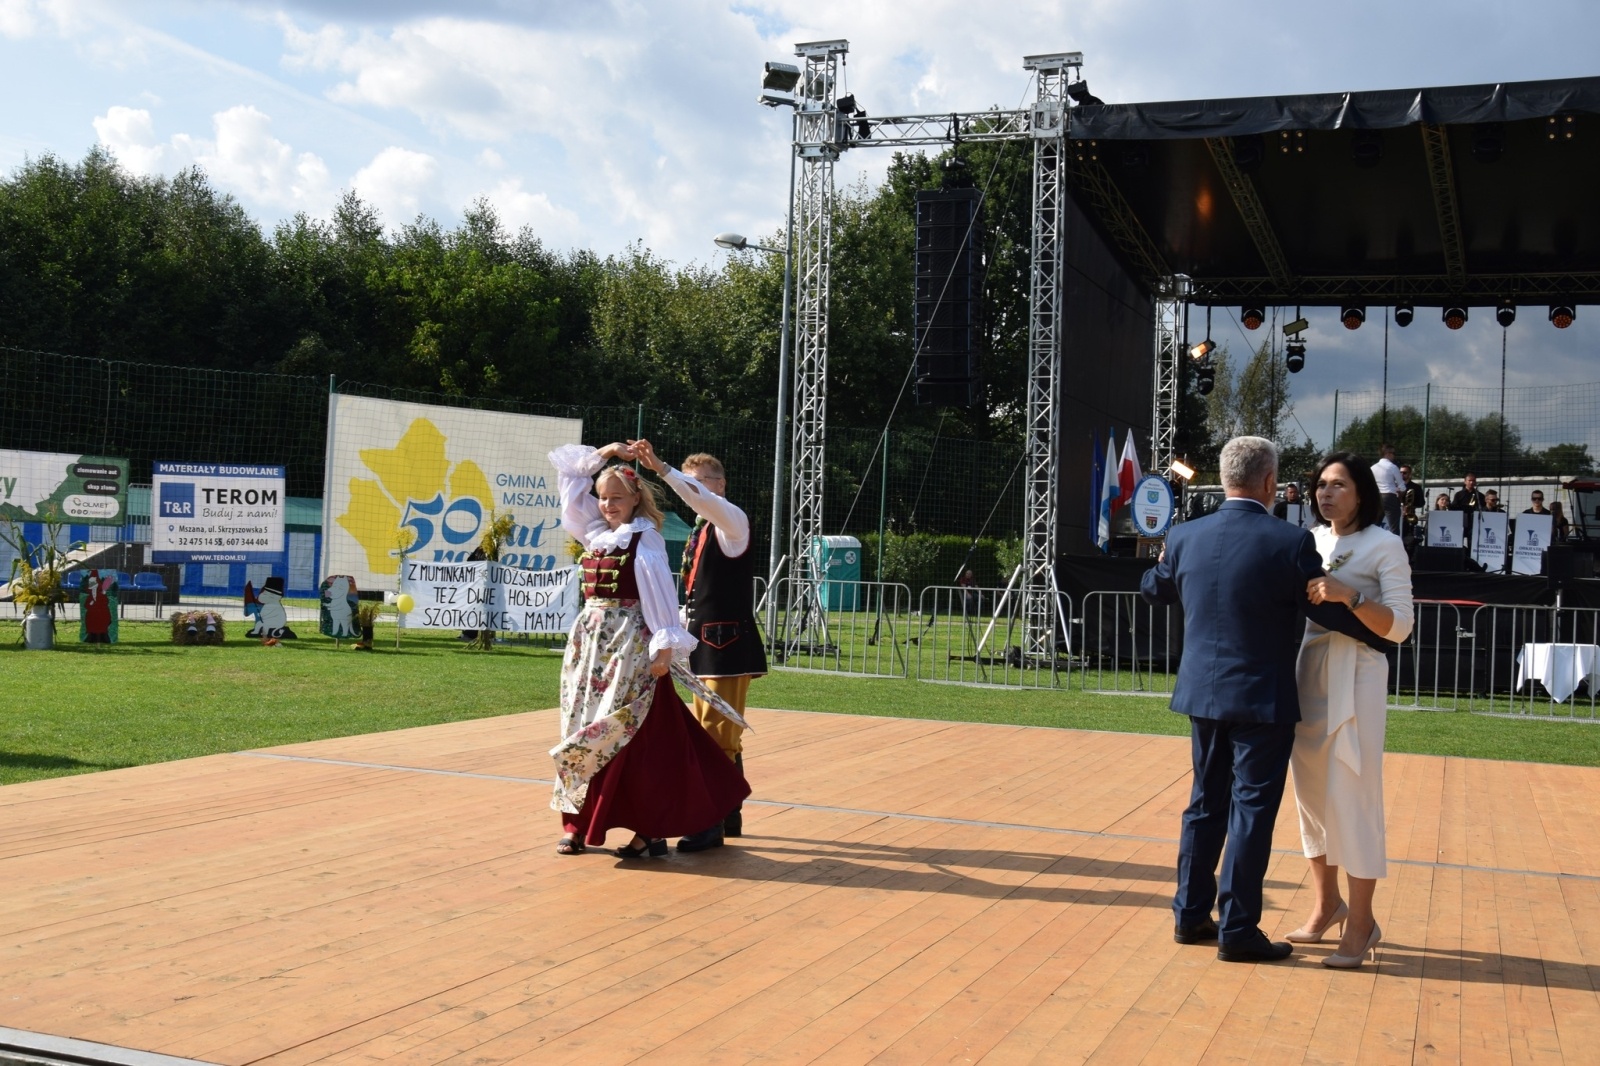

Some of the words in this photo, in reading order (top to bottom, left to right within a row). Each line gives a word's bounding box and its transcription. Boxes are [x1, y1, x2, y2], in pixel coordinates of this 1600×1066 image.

[160, 464, 216, 474] MATERIAŁY
[219, 466, 279, 476] BUDOWLANE
[0, 477, 17, 499] y
[496, 473, 547, 489] GMINA
[202, 488, 277, 505] TEROM
[163, 501, 191, 514] T&R
[202, 508, 233, 520] Buduj
[247, 509, 278, 518] nami!
[179, 525, 207, 534] Mszana,
[208, 525, 217, 533] ul.
[218, 526, 263, 535] Skrzyszowska
[398, 493, 482, 555] 50
[505, 514, 562, 548] at
[226, 538, 239, 546] 607
[241, 538, 254, 546] 344
[255, 538, 268, 546] 404
[408, 563, 417, 581] Z
[420, 565, 476, 583] MUMINKAMI
[433, 585, 457, 604] TEŻ
[468, 587, 496, 606] DWIE
[508, 588, 553, 607] HOŁDY
[560, 591, 565, 607] I
[524, 611, 566, 631] MAMY
